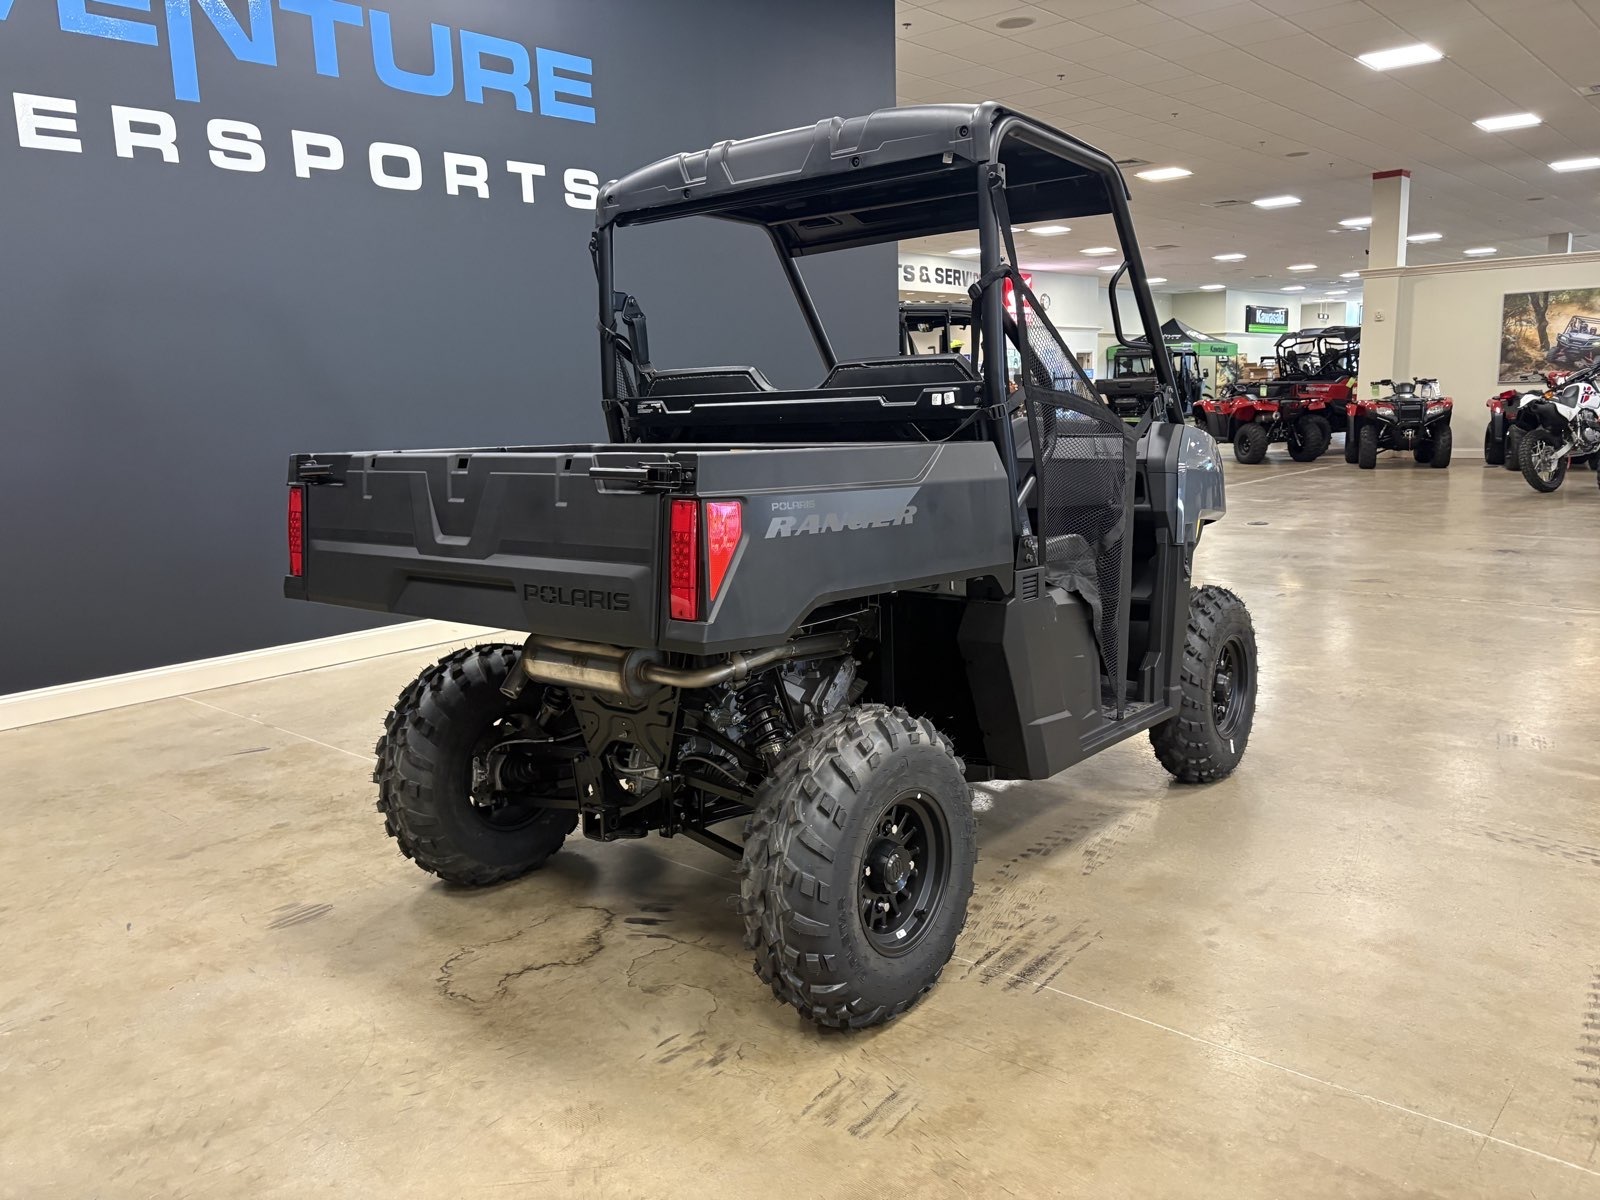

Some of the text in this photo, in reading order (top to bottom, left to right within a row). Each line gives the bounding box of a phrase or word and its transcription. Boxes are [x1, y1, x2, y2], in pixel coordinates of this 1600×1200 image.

[13, 92, 600, 210] ERSPORTS
[920, 265, 932, 284] &
[1256, 309, 1285, 324] Kawasaki
[771, 500, 816, 511] POLARIS
[523, 583, 630, 611] POLARIS
